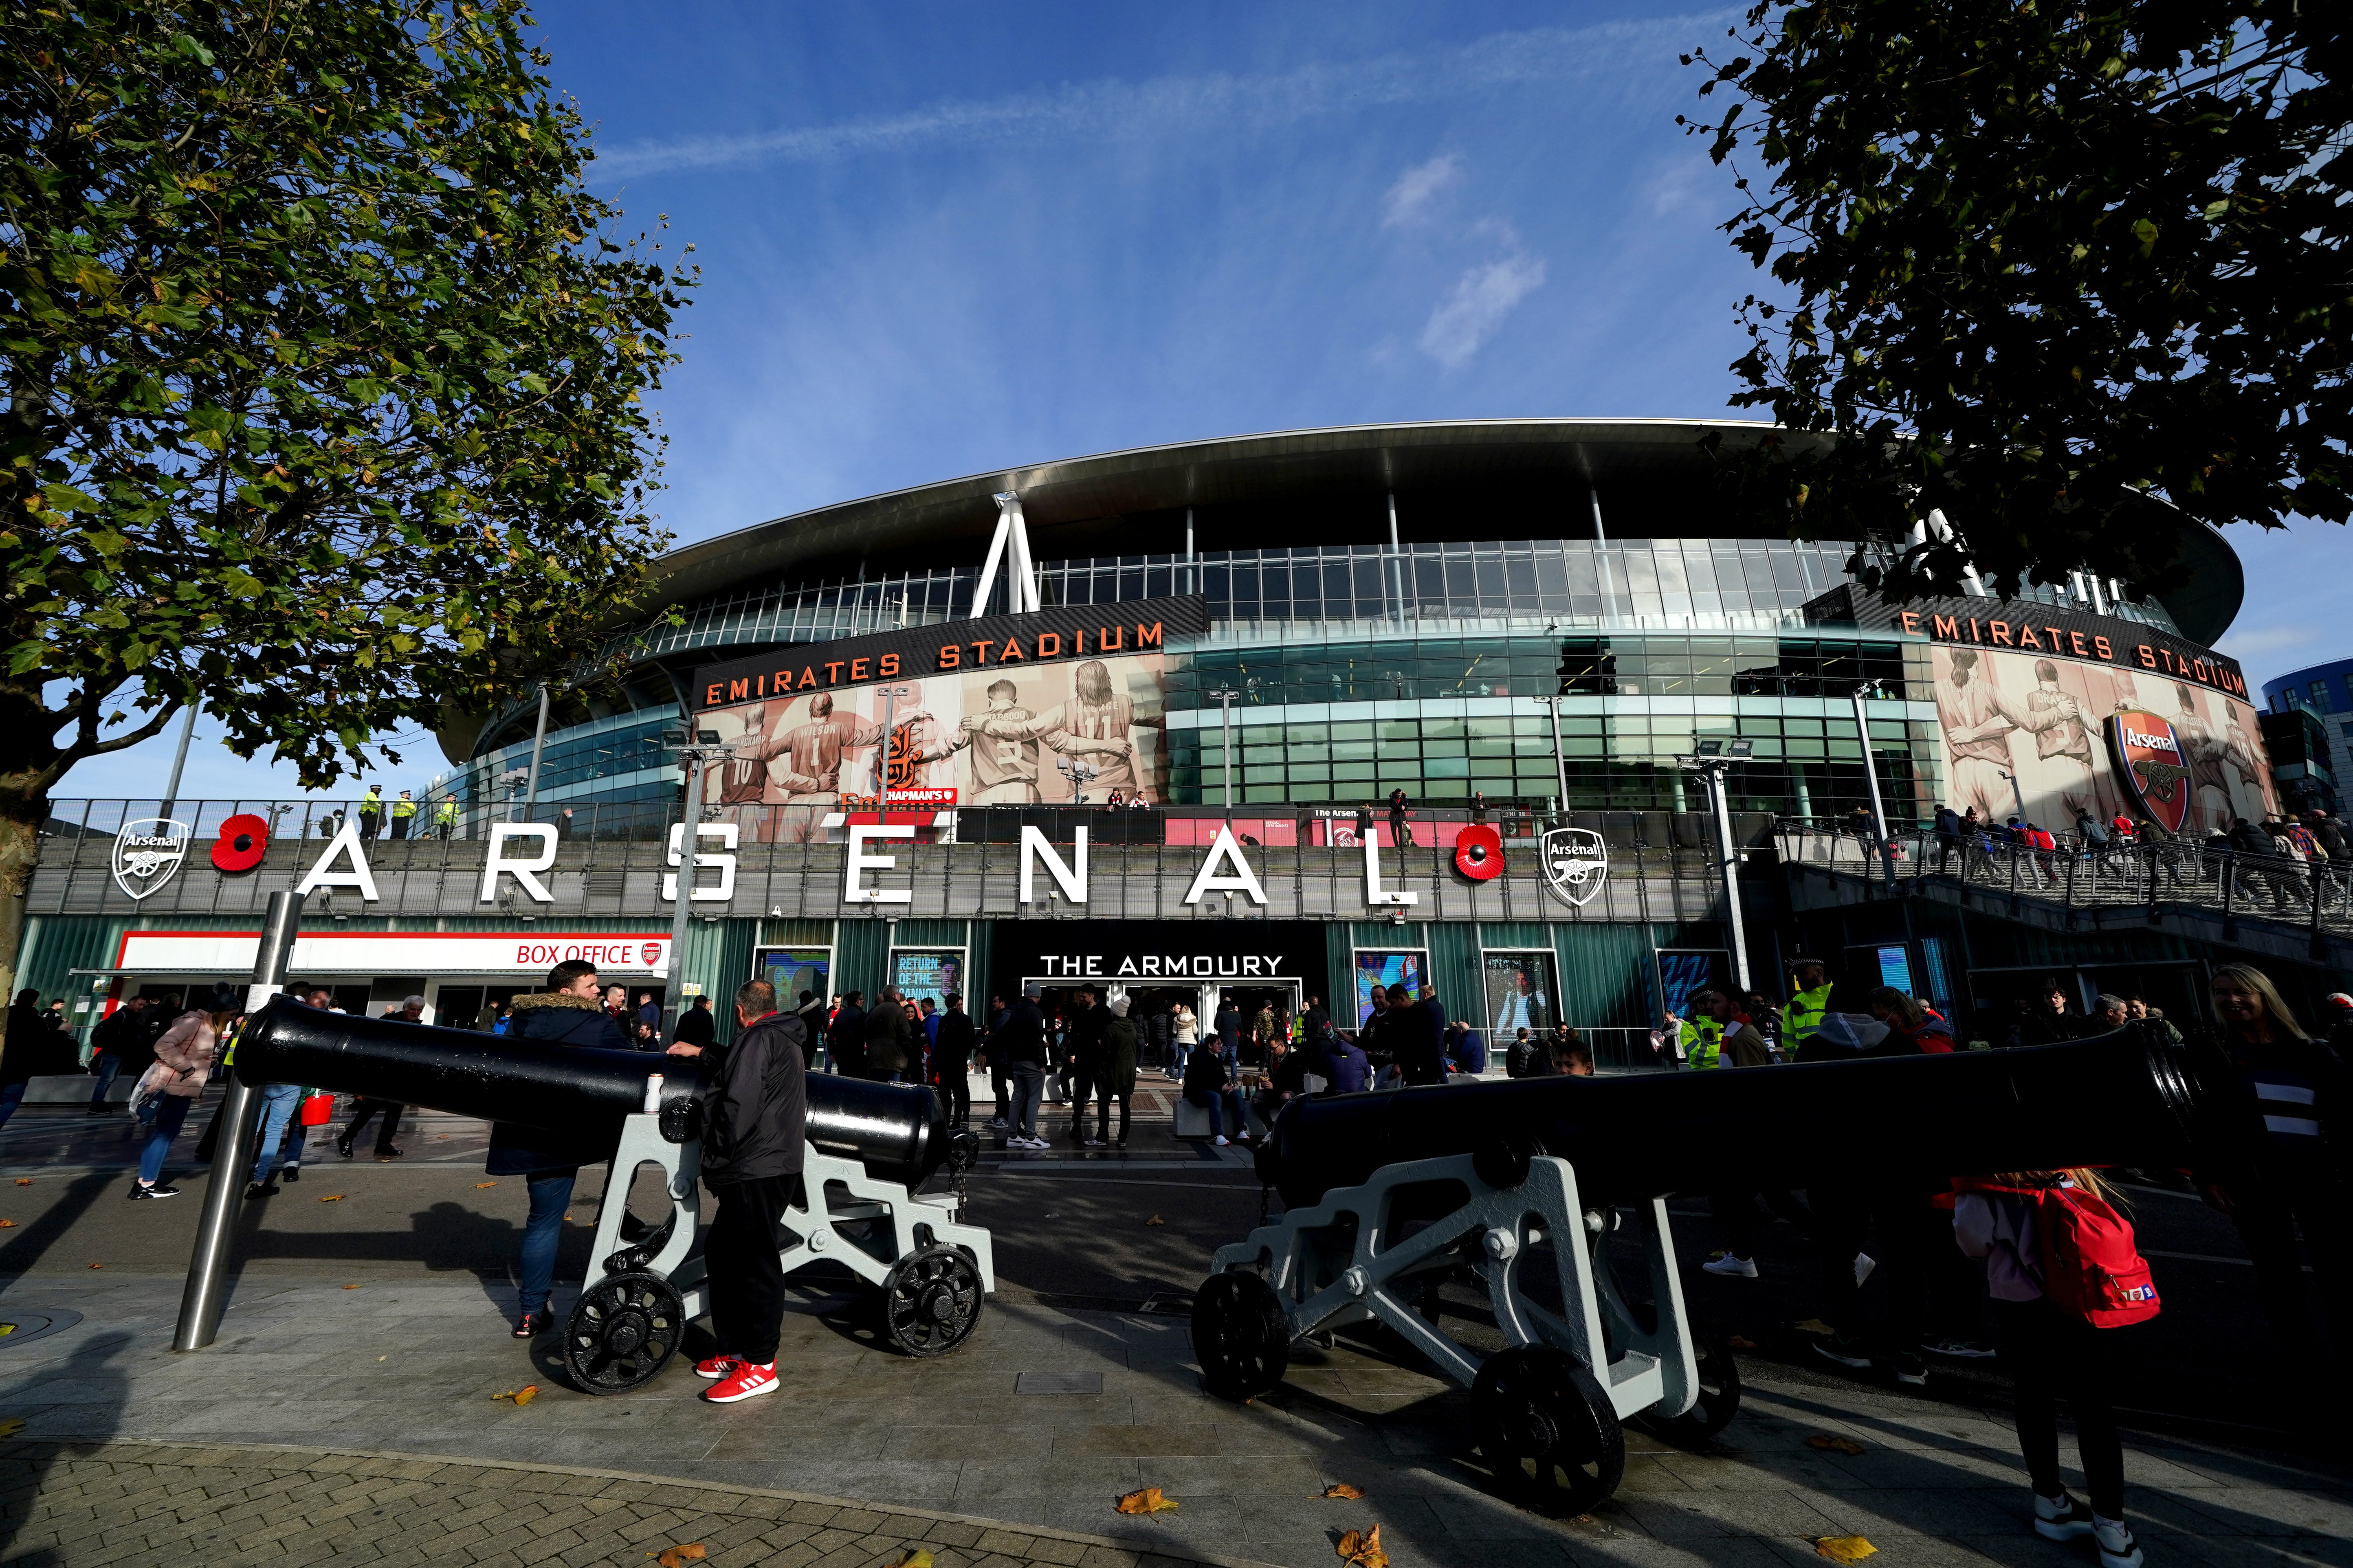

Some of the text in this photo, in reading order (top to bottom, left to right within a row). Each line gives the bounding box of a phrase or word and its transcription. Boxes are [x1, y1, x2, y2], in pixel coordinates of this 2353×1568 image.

[706, 621, 1162, 705] EMIRATES STADIUM
[1899, 611, 2246, 697] EMIRATES STADIUM
[1944, 682, 1983, 694] SEAMAN
[2180, 714, 2203, 727] ROCASTLE
[801, 724, 836, 738] WILSON
[2126, 727, 2178, 752] Arsenal
[809, 738, 820, 766] 1
[733, 758, 753, 785] 10
[125, 834, 178, 846] Arsenal
[1550, 843, 1598, 855] Arsenal
[293, 817, 1418, 906] ARSENAL
[517, 945, 633, 963] BOX OFFICE
[899, 957, 938, 970] RETURN
[1040, 955, 1283, 975] THE ARMOURY
[899, 973, 932, 985] OF THE
